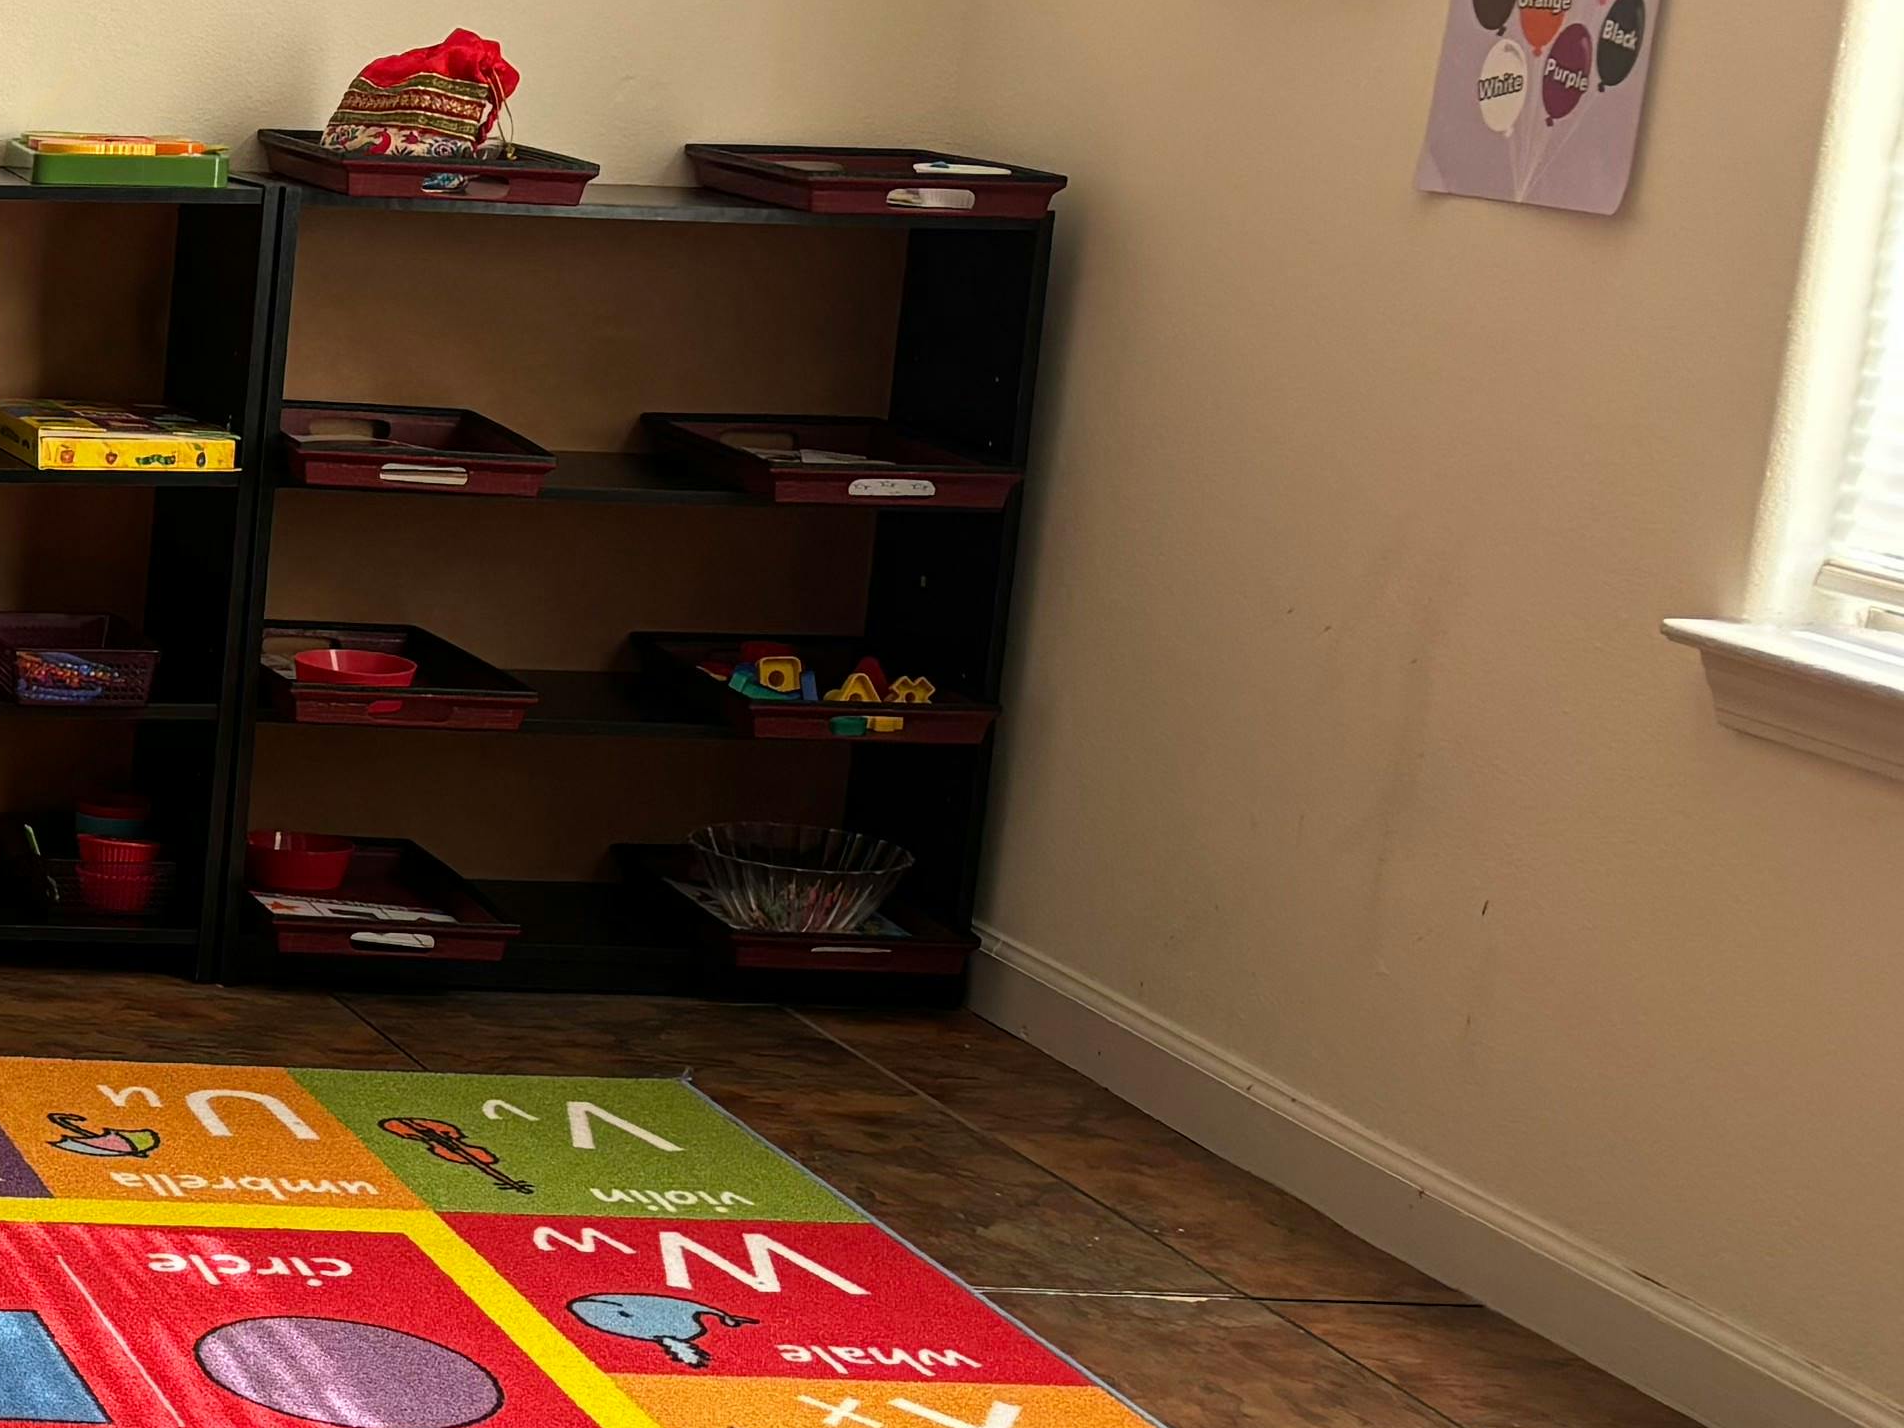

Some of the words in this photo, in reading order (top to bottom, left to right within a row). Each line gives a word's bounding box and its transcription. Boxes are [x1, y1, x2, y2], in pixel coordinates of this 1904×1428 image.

[1602, 20, 1638, 52] Black
[1478, 73, 1525, 101] White
[1544, 58, 1588, 92] Purple
[110, 1172, 378, 1200] umbrella
[591, 1188, 753, 1213] violin
[149, 1249, 352, 1281] circle
[775, 1342, 984, 1376] whale
